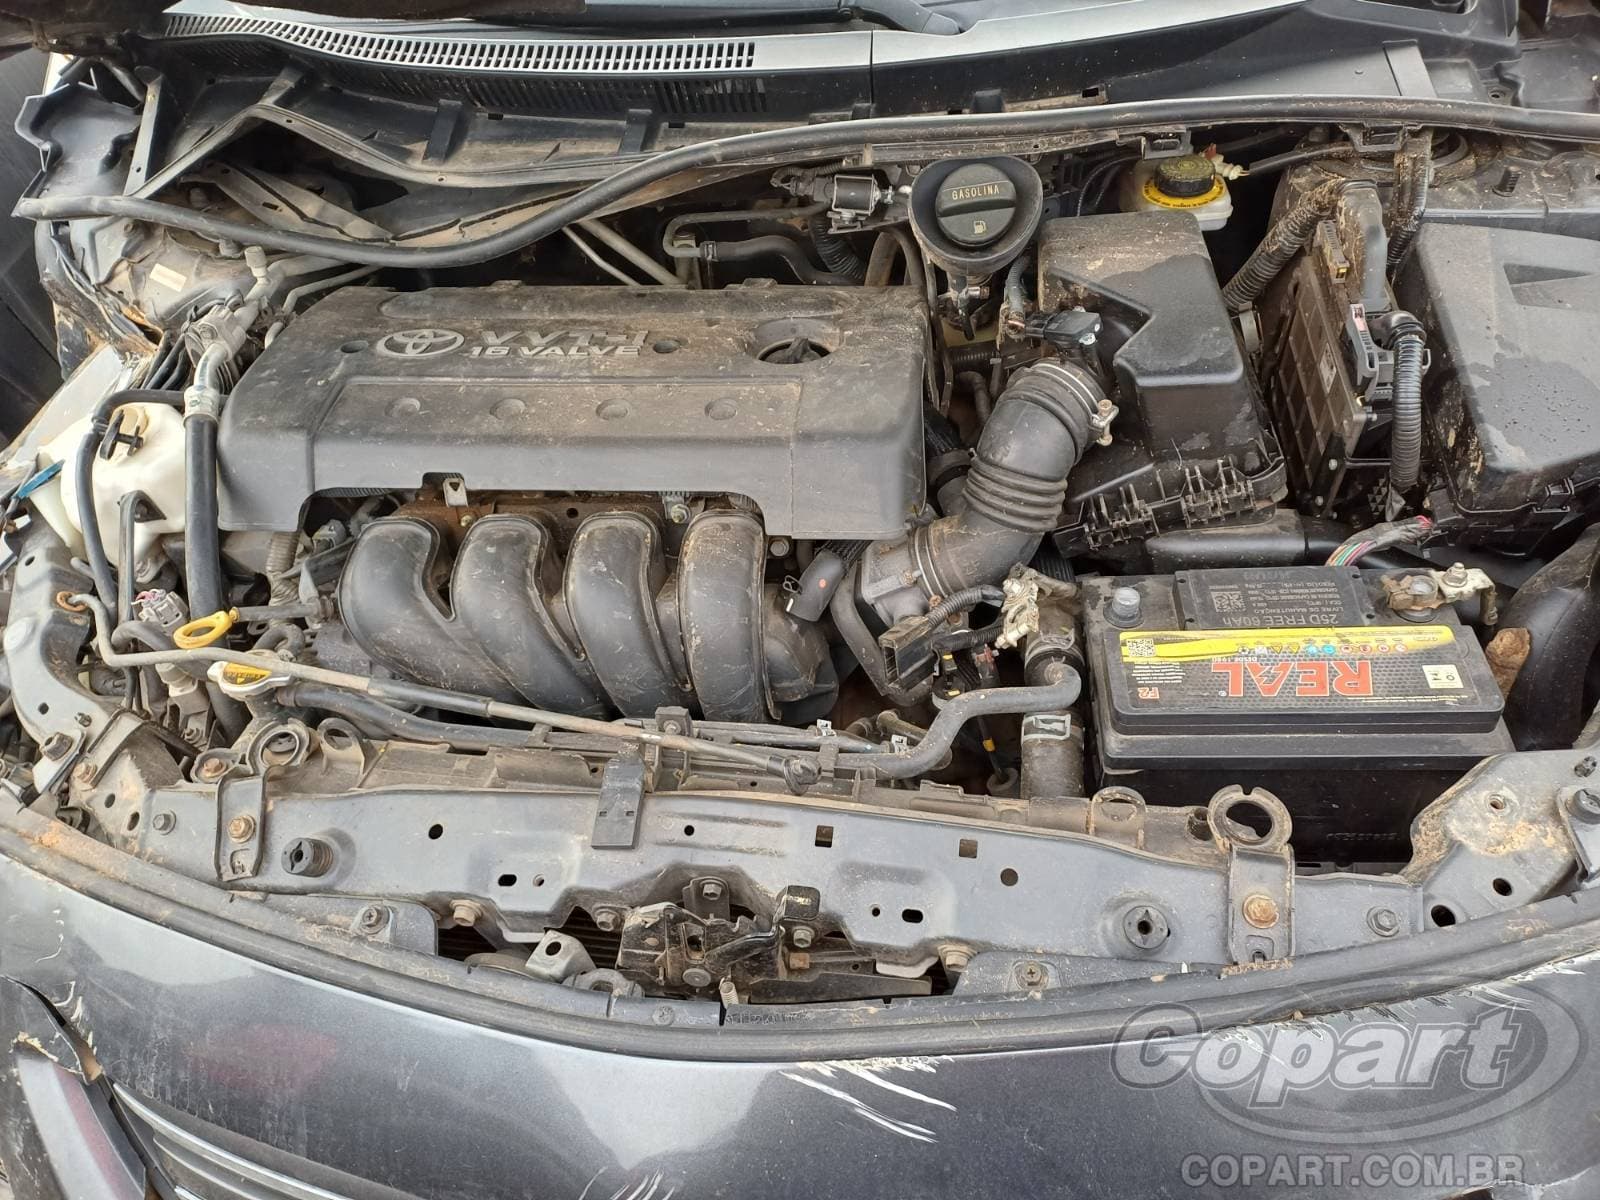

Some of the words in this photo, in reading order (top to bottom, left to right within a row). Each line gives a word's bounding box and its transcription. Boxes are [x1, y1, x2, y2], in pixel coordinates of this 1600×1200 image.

[951, 184, 1000, 200] GASOLINA
[469, 345, 511, 358] 16
[519, 344, 643, 358] VALVE
[1222, 616, 1260, 627] 60Ah
[1263, 614, 1306, 625] FREE
[1309, 614, 1338, 625] 25D
[1211, 660, 1374, 697] REAL
[1138, 687, 1160, 700] F2
